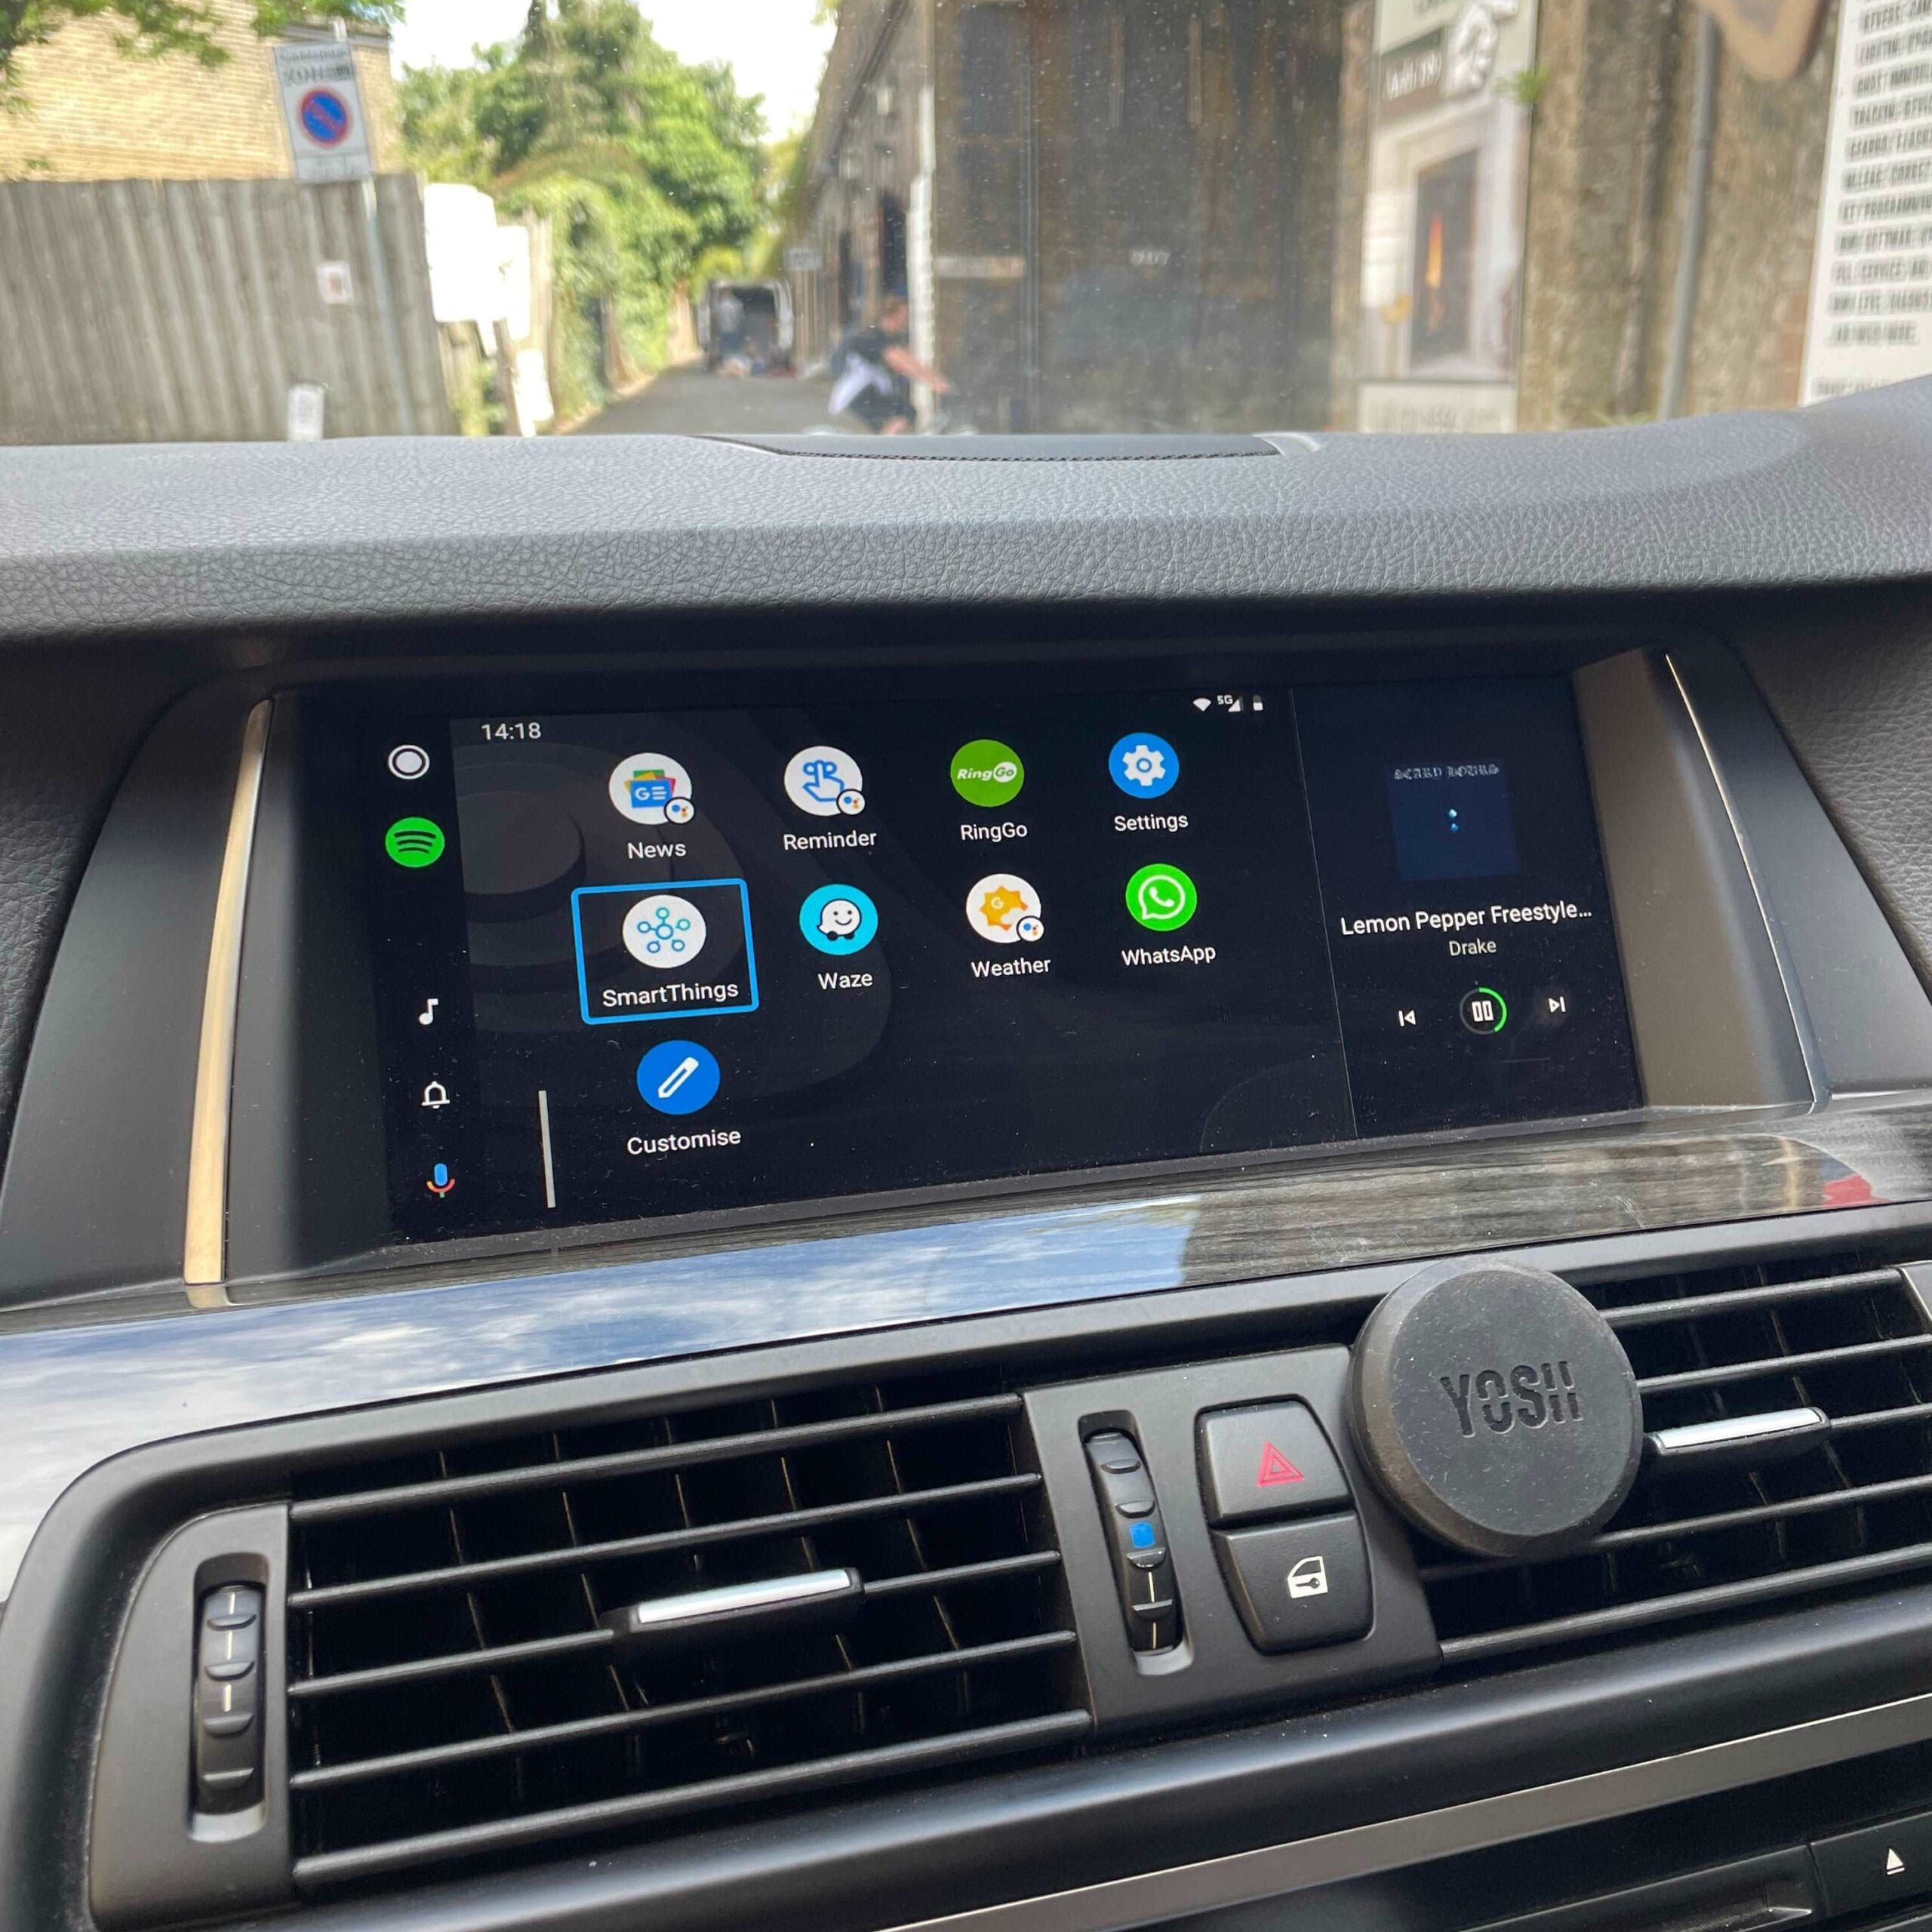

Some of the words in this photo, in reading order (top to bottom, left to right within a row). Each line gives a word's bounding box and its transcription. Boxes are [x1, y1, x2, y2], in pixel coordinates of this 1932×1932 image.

[1217, 694, 1233, 706] 5G
[481, 721, 543, 741] 14:18
[957, 763, 1016, 781] RingGo
[960, 821, 1029, 844] RingGo
[1114, 813, 1189, 833] Settings
[627, 841, 688, 860] News
[783, 829, 878, 851] Reminder
[1340, 915, 1411, 936] Lemon
[1415, 910, 1486, 933] Pepper
[1121, 945, 1217, 967] WhatsApp
[1448, 937, 1497, 957] Drake
[971, 956, 1052, 979] Weather
[817, 972, 874, 991] Waze
[602, 983, 740, 1008] SmartThings
[626, 1129, 742, 1155] Customise
[1440, 1361, 1583, 1438] YOSH
